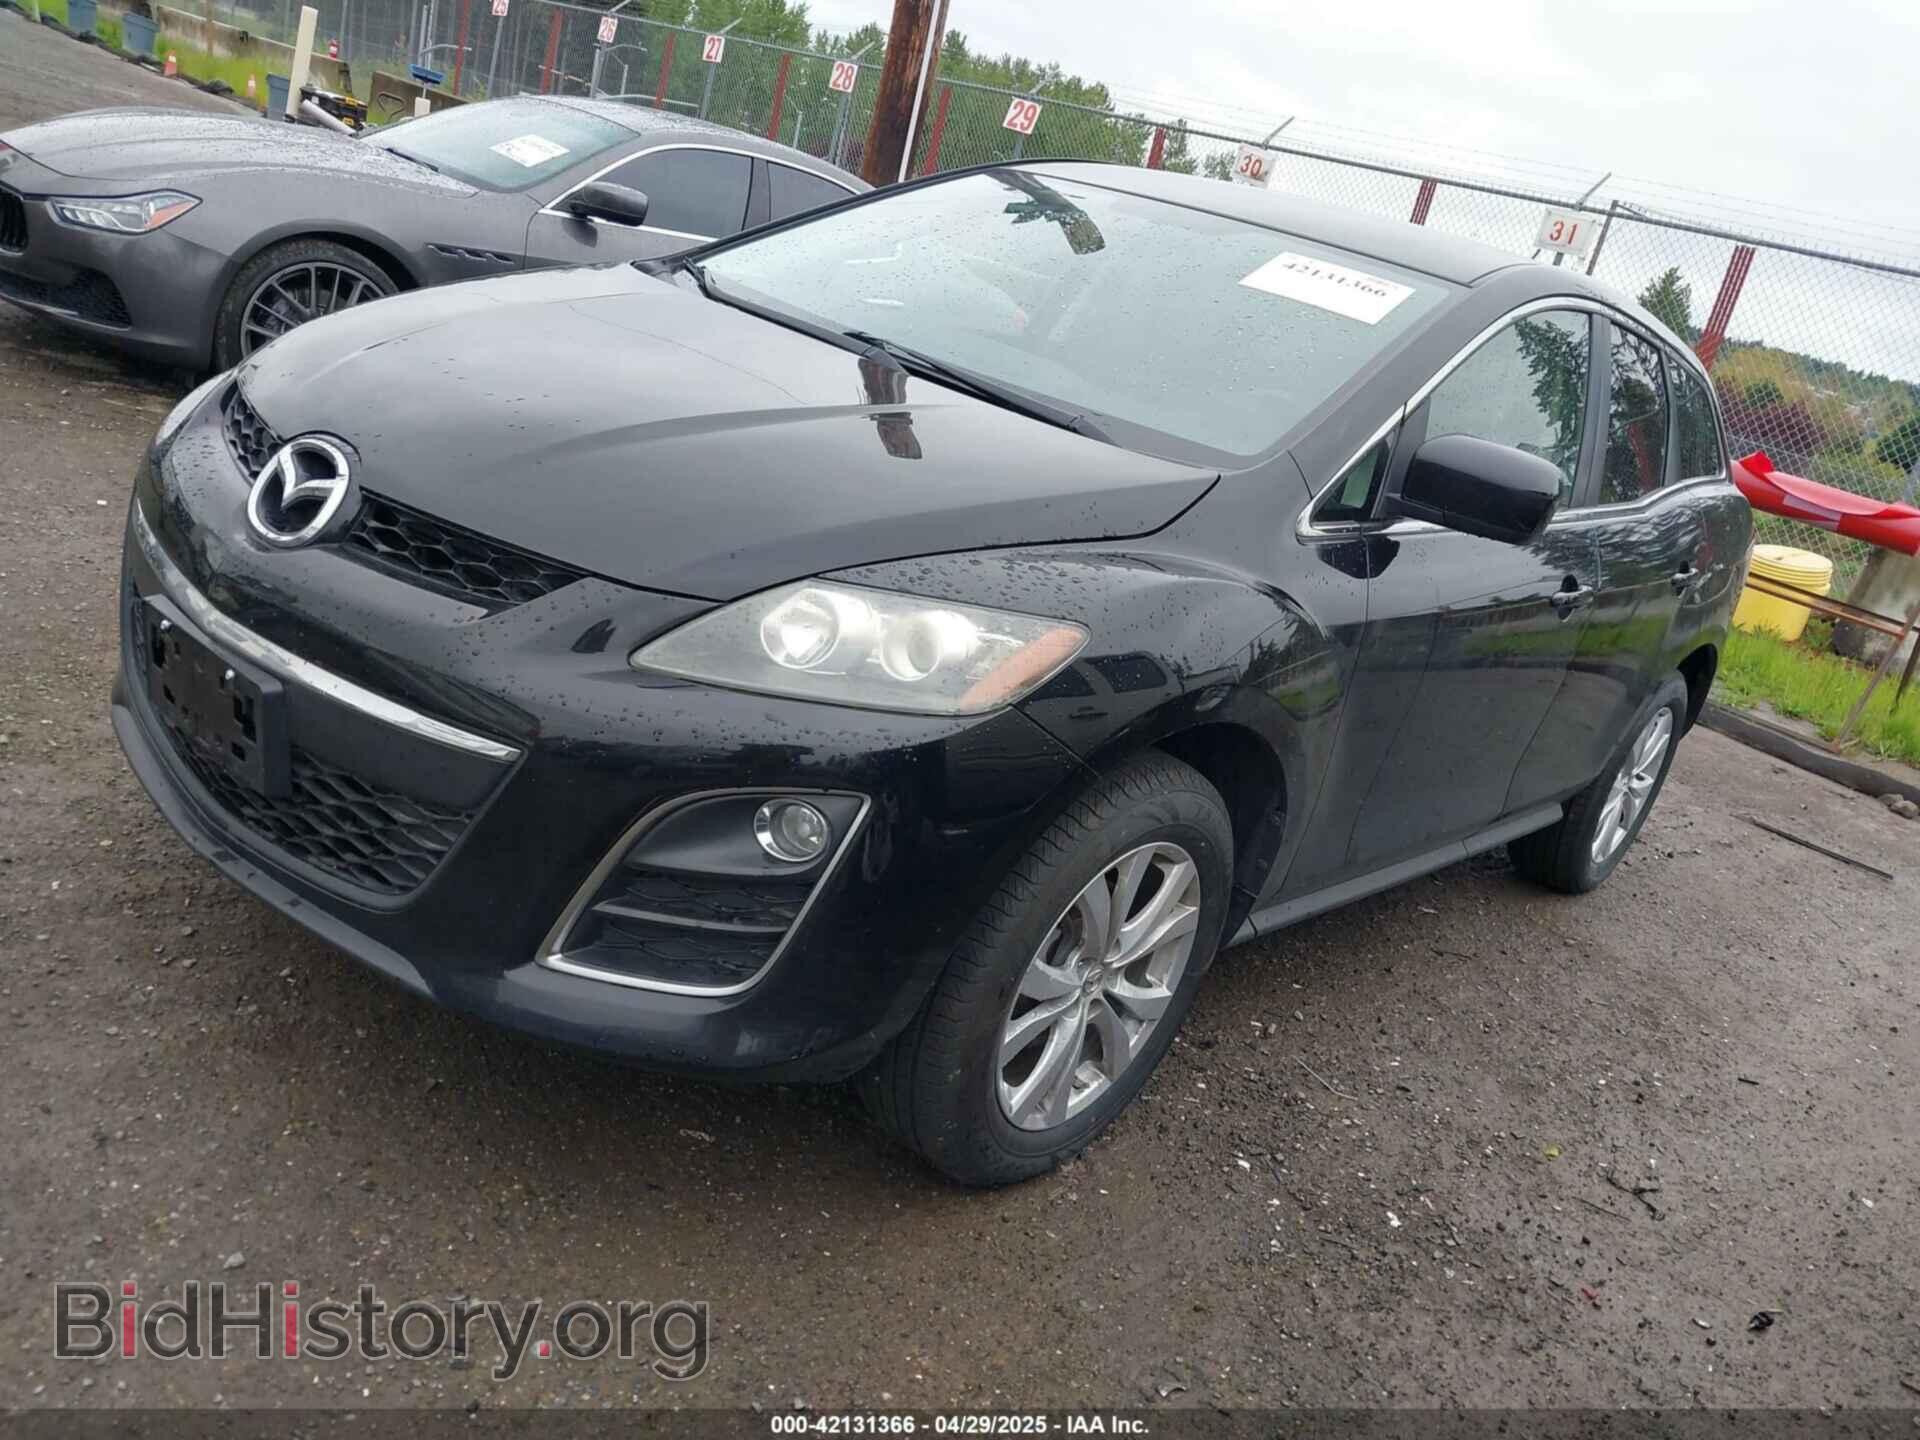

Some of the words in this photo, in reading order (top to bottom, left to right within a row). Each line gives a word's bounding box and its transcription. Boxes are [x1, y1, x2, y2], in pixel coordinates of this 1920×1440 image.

[599, 18, 617, 41] 26
[705, 36, 722, 60] 27
[831, 62, 855, 90] 28
[1006, 100, 1039, 131] 29
[1239, 153, 1263, 177] 30
[1549, 220, 1578, 245] 31
